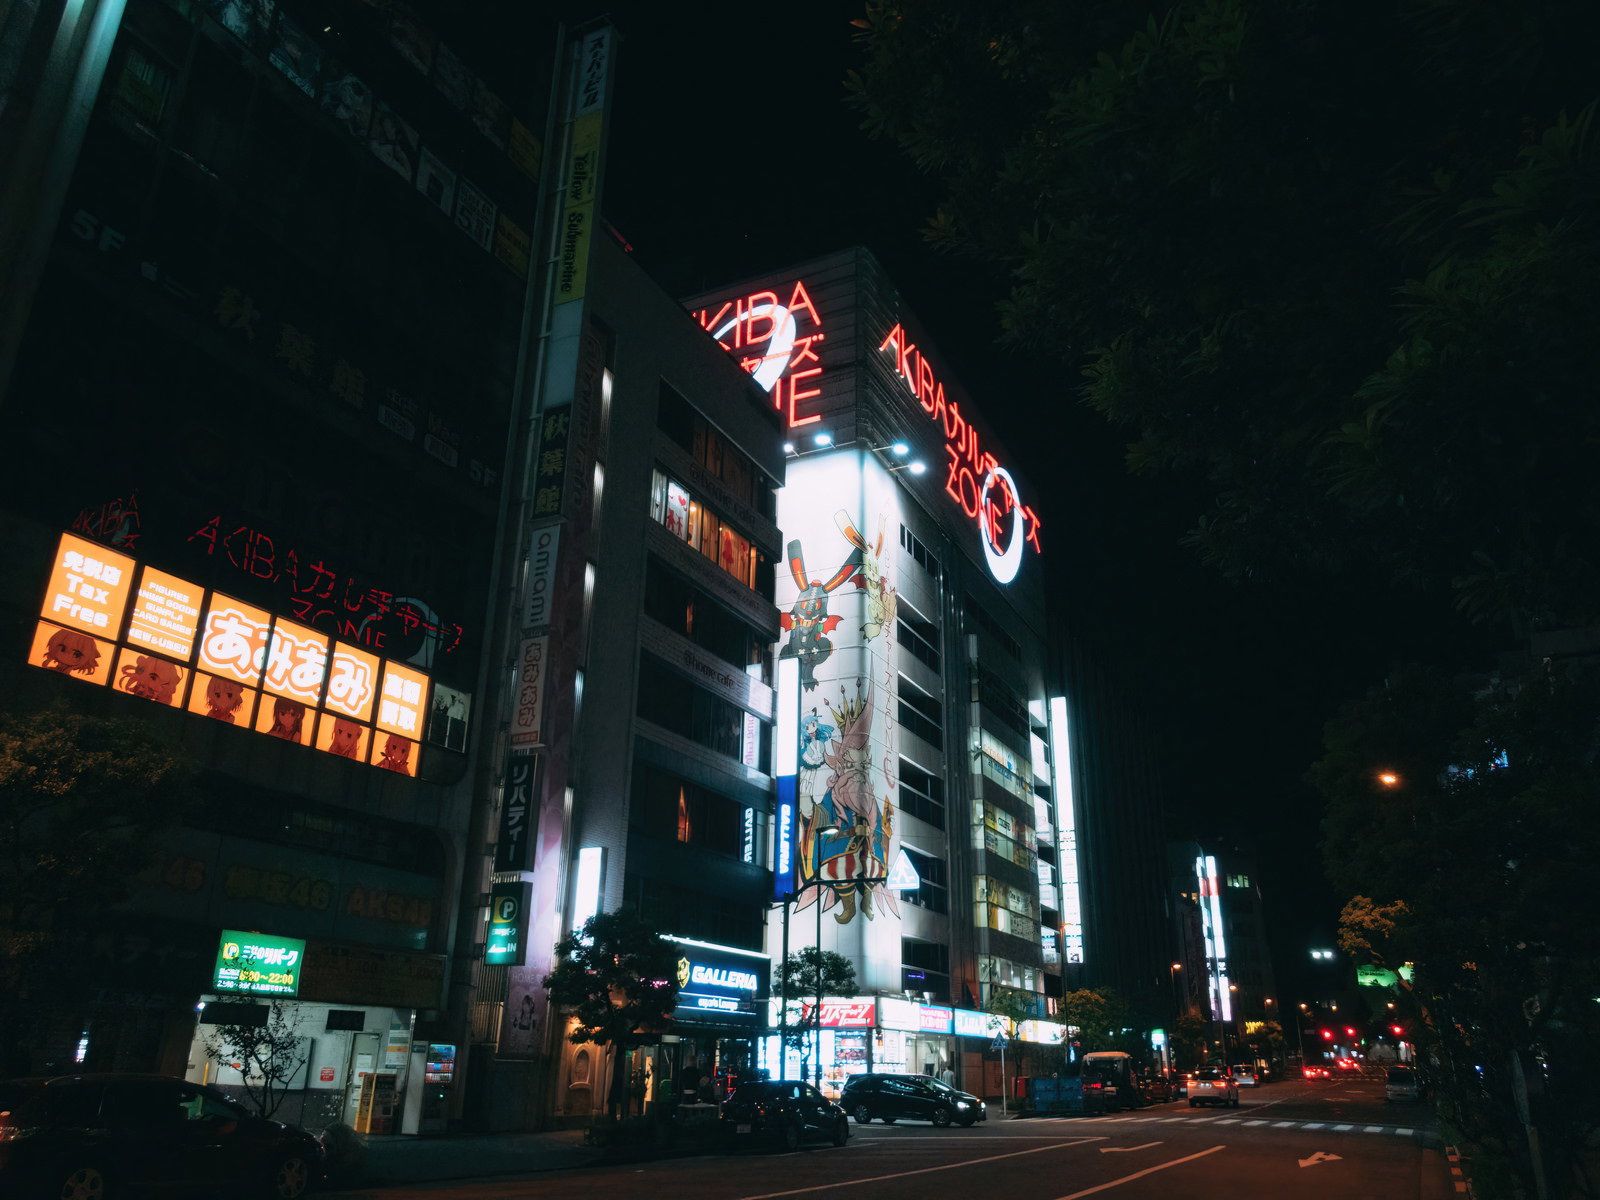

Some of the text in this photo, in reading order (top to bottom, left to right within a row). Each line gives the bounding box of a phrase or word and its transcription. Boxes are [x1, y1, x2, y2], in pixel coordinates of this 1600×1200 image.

[72, 209, 126, 251] 5F
[560, 152, 589, 292] Yellow Submarine
[691, 280, 823, 352] KIBA
[534, 414, 571, 514] 秋葉館
[945, 443, 1004, 556] ZONE
[65, 572, 110, 605] Tax
[148, 581, 190, 604] FIGURES
[530, 532, 551, 623] amiami
[52, 593, 110, 628] Free
[145, 602, 184, 623] GUNPLA
[159, 618, 193, 636] GAMES
[165, 597, 199, 617] GOODS
[201, 610, 372, 715] あみあみ
[518, 642, 542, 728] あみあみ
[507, 763, 528, 862] リバティー
[780, 803, 791, 875] GALLERIA
[506, 943, 517, 953] IN
[692, 965, 758, 991] GALLERIA
